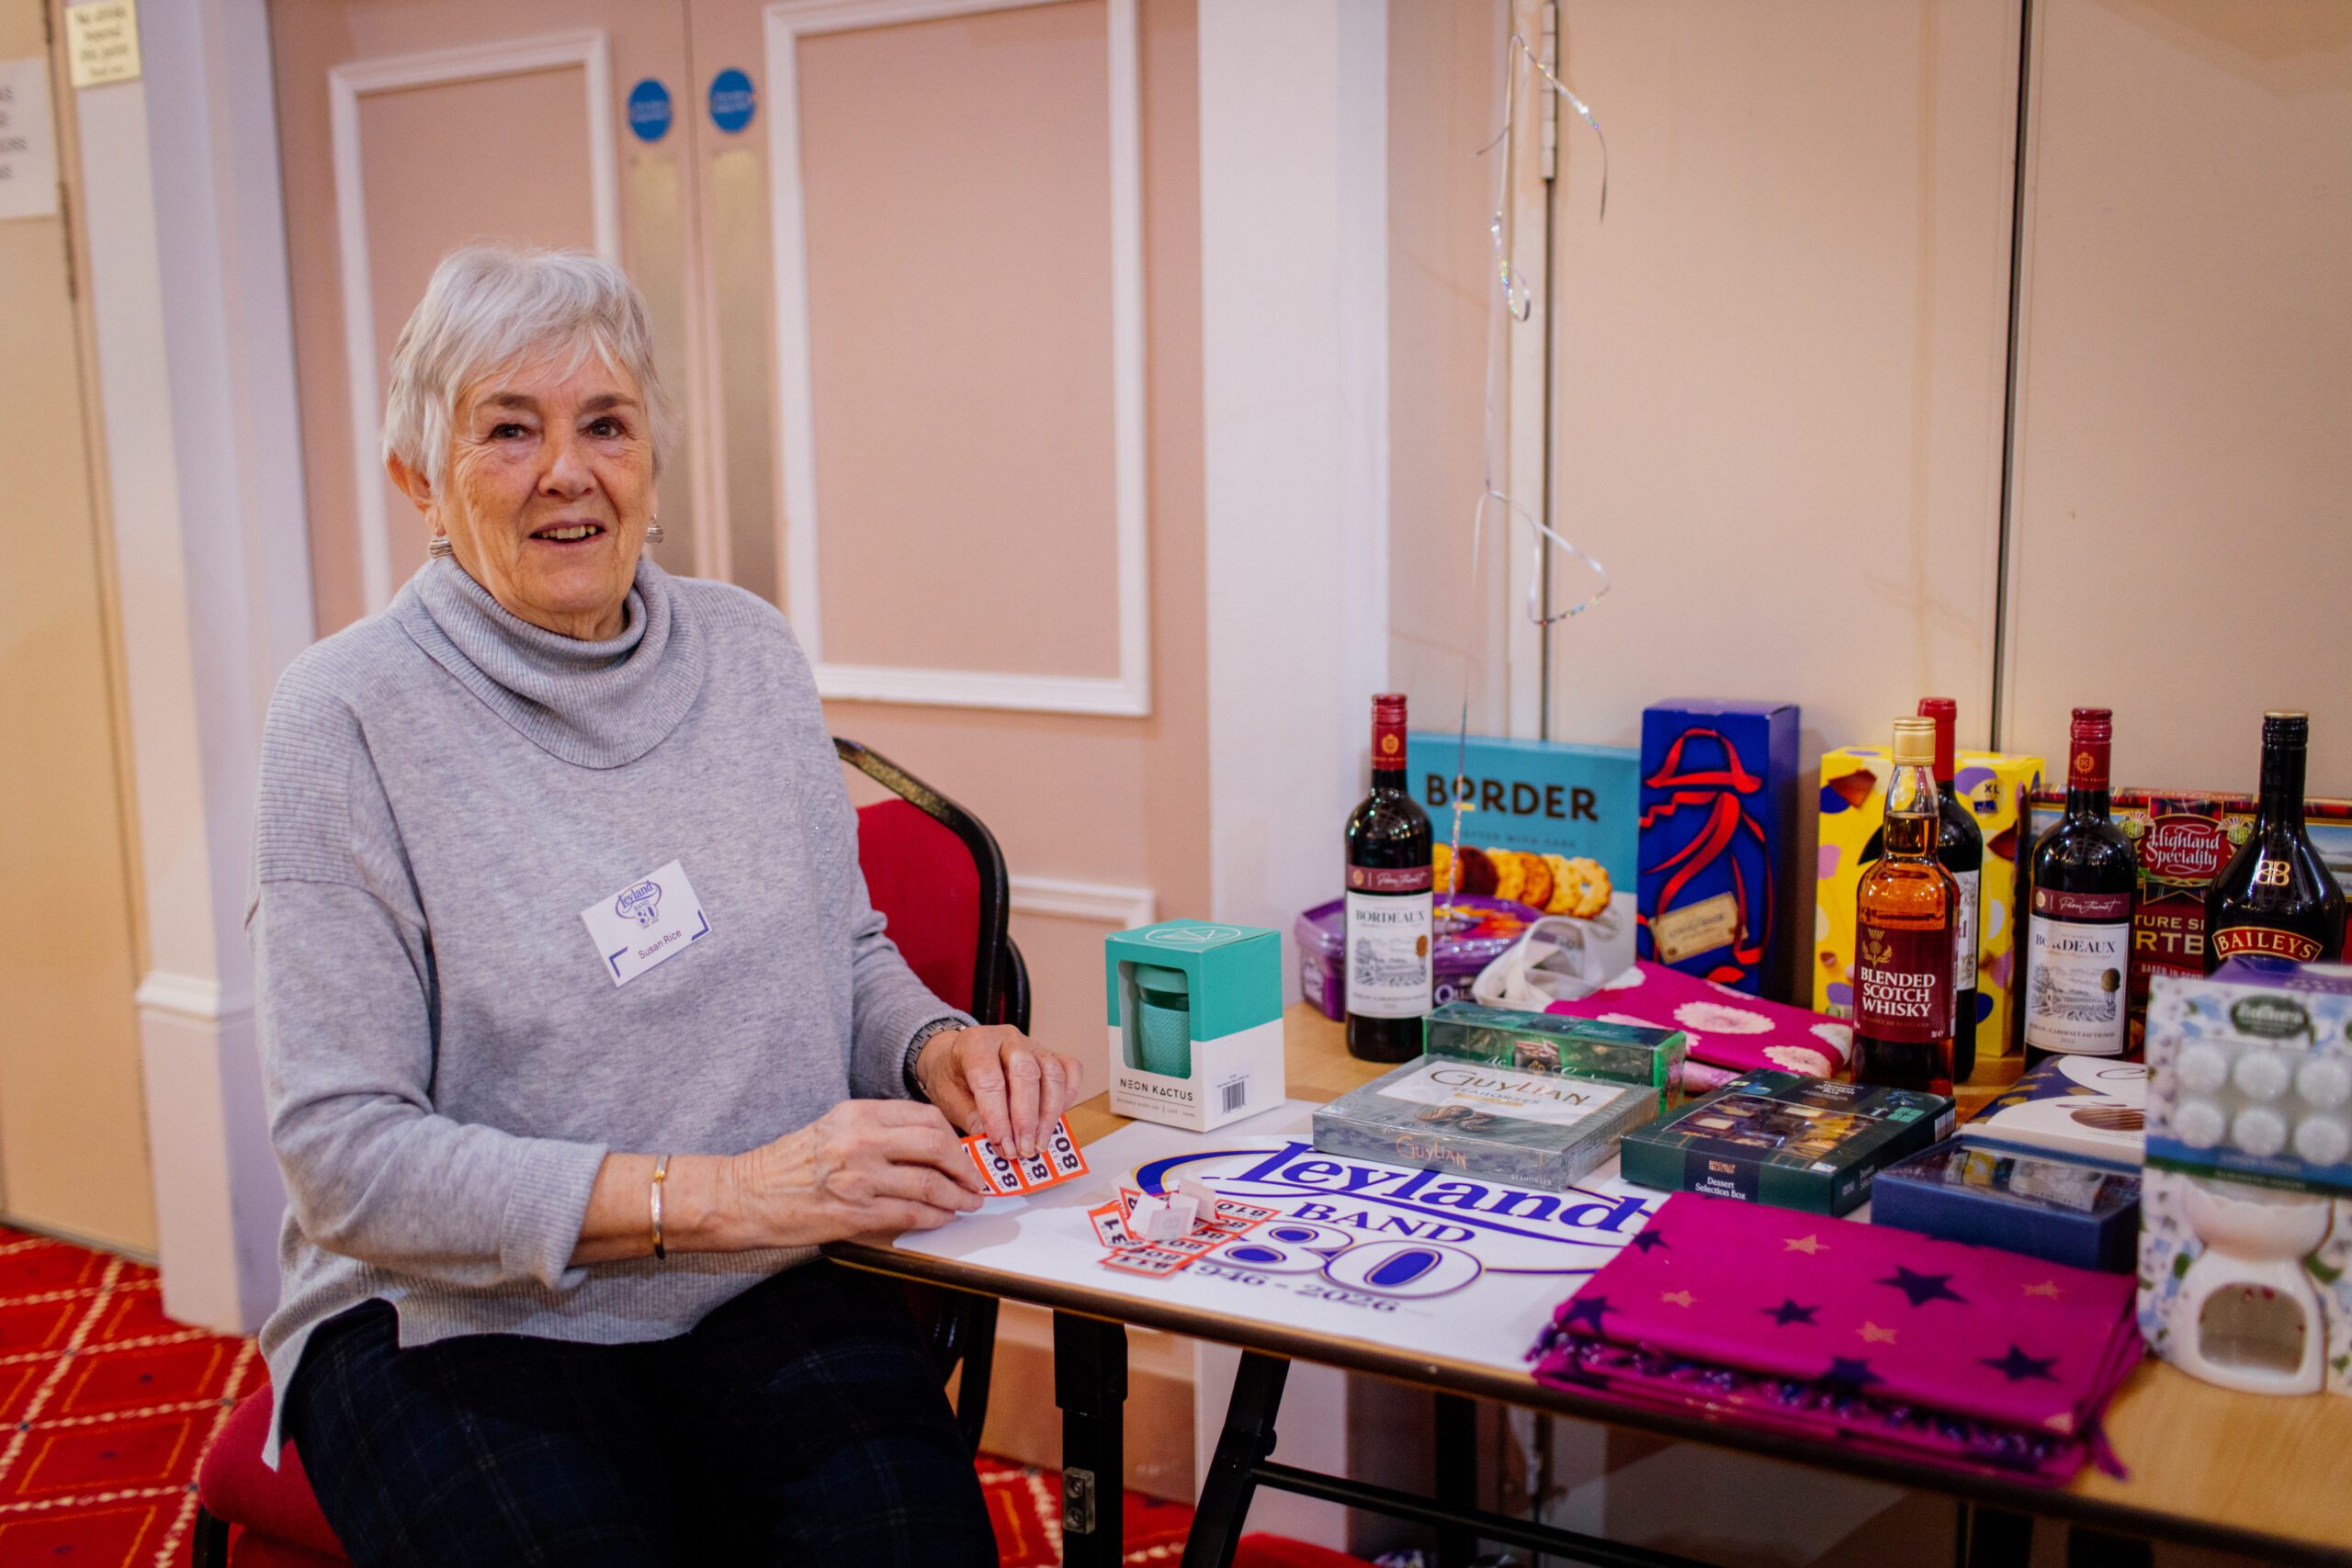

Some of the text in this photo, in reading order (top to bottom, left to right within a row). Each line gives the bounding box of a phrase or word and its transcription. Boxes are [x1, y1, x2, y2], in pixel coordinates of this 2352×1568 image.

[1427, 773, 1599, 823] BORDER
[2147, 823, 2220, 852] Highland
[2145, 847, 2217, 874] Speciality
[639, 930, 682, 959] Susan Rice
[2218, 931, 2314, 958] BAILEYS
[1860, 966, 1936, 987] BLENDED
[1863, 983, 1930, 1002] SCOTCH
[1862, 997, 1932, 1017] WHISKY
[1120, 1078, 1148, 1092] NEON
[1152, 1087, 1193, 1101] KACTUS
[1510, 1174, 1553, 1186] SEAHORSES
[1695, 1182, 1746, 1200] Selection Box
[1707, 1176, 1735, 1189] Dessert
[1289, 1202, 1476, 1242] BAND
[1295, 1283, 1399, 1314] 2026
